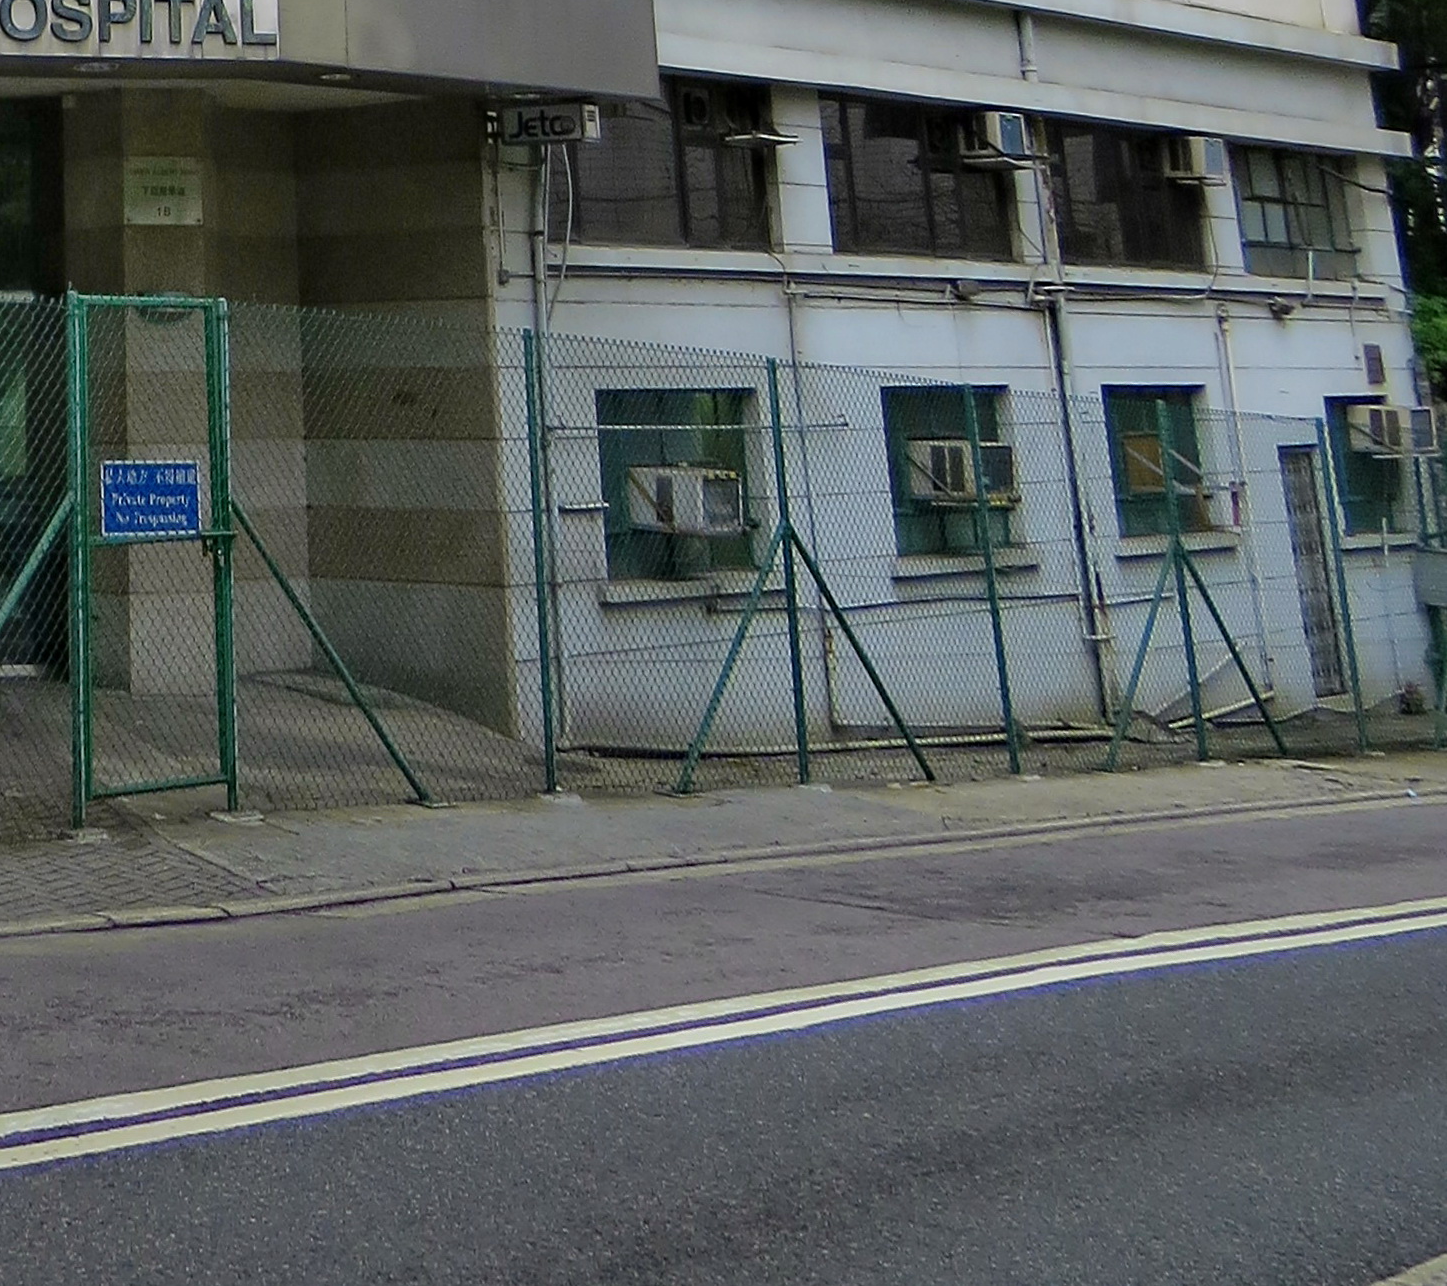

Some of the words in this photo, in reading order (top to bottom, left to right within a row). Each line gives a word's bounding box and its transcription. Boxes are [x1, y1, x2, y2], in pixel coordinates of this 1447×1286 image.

[112, 493, 146, 506] Private
[149, 493, 189, 508] Property
[116, 512, 130, 524] No
